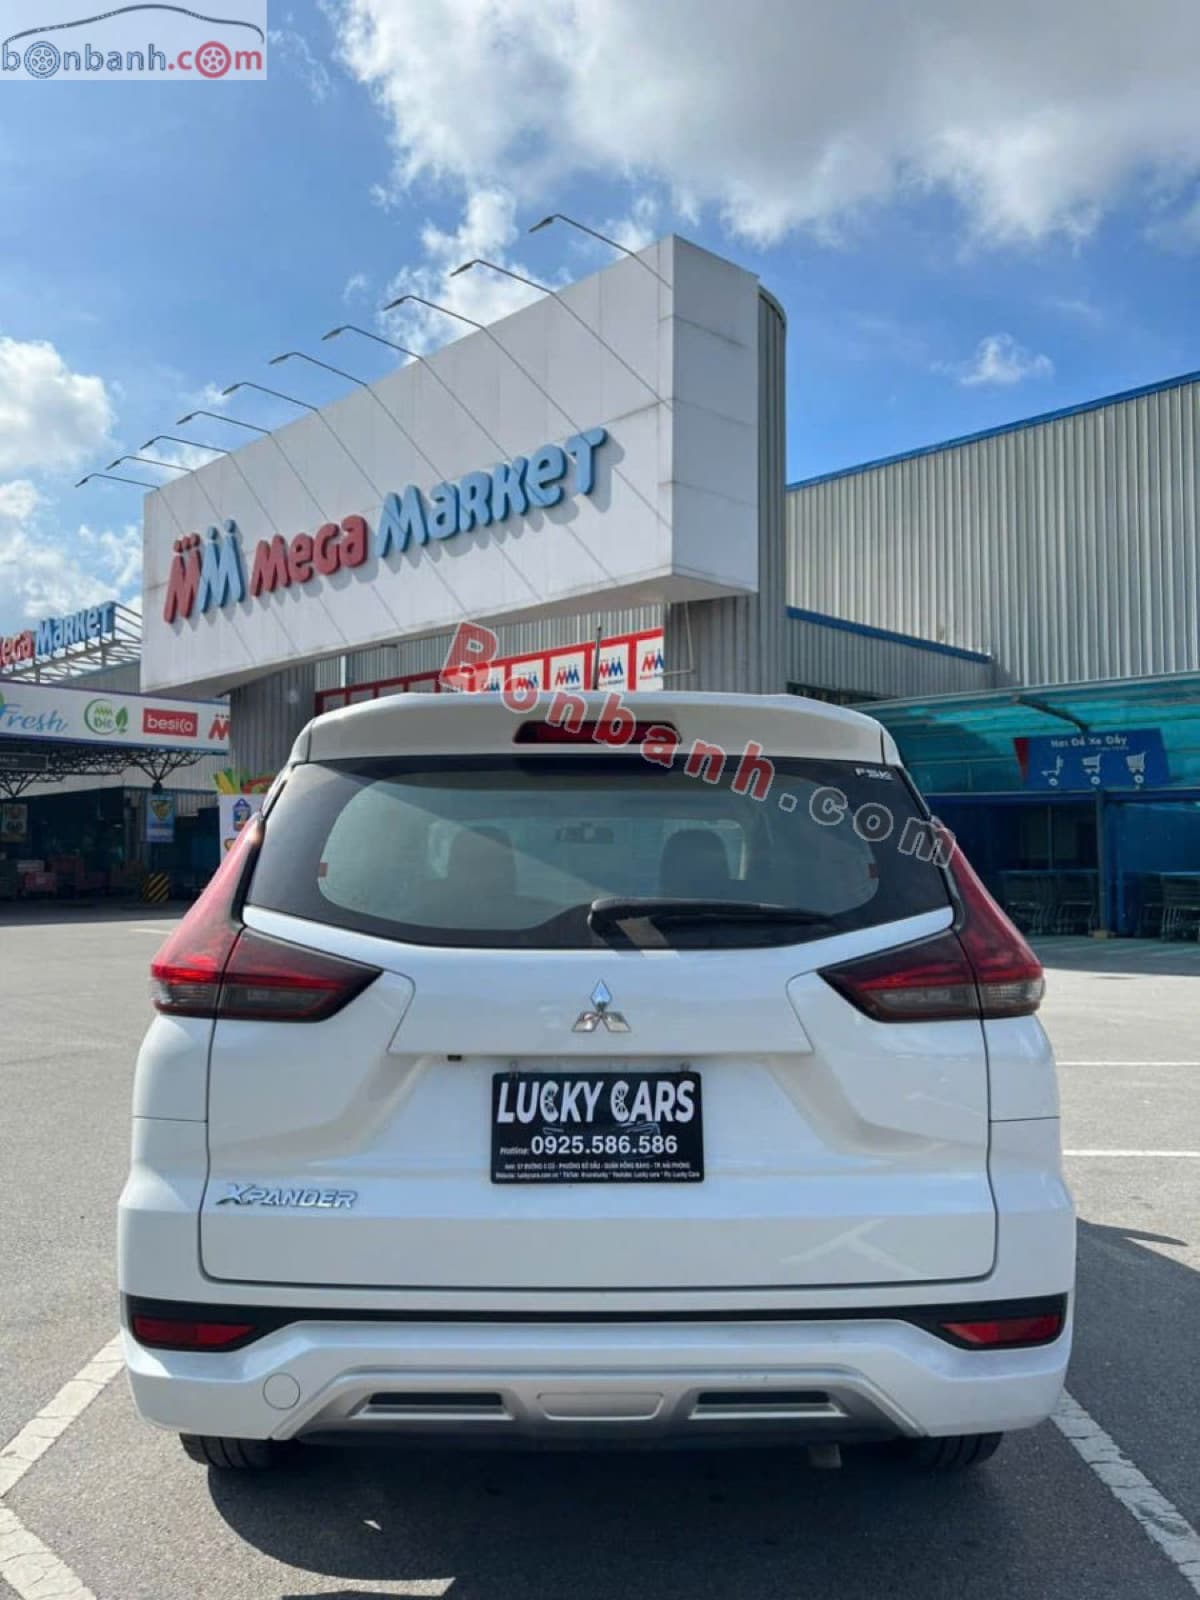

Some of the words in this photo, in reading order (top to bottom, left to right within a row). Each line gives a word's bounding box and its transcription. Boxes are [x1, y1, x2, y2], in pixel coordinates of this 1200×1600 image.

[497, 1081, 604, 1124] LUCKY
[610, 1080, 695, 1123] CARS
[531, 1135, 678, 1155] 0925.586.586
[216, 1183, 357, 1208] XPANDER
